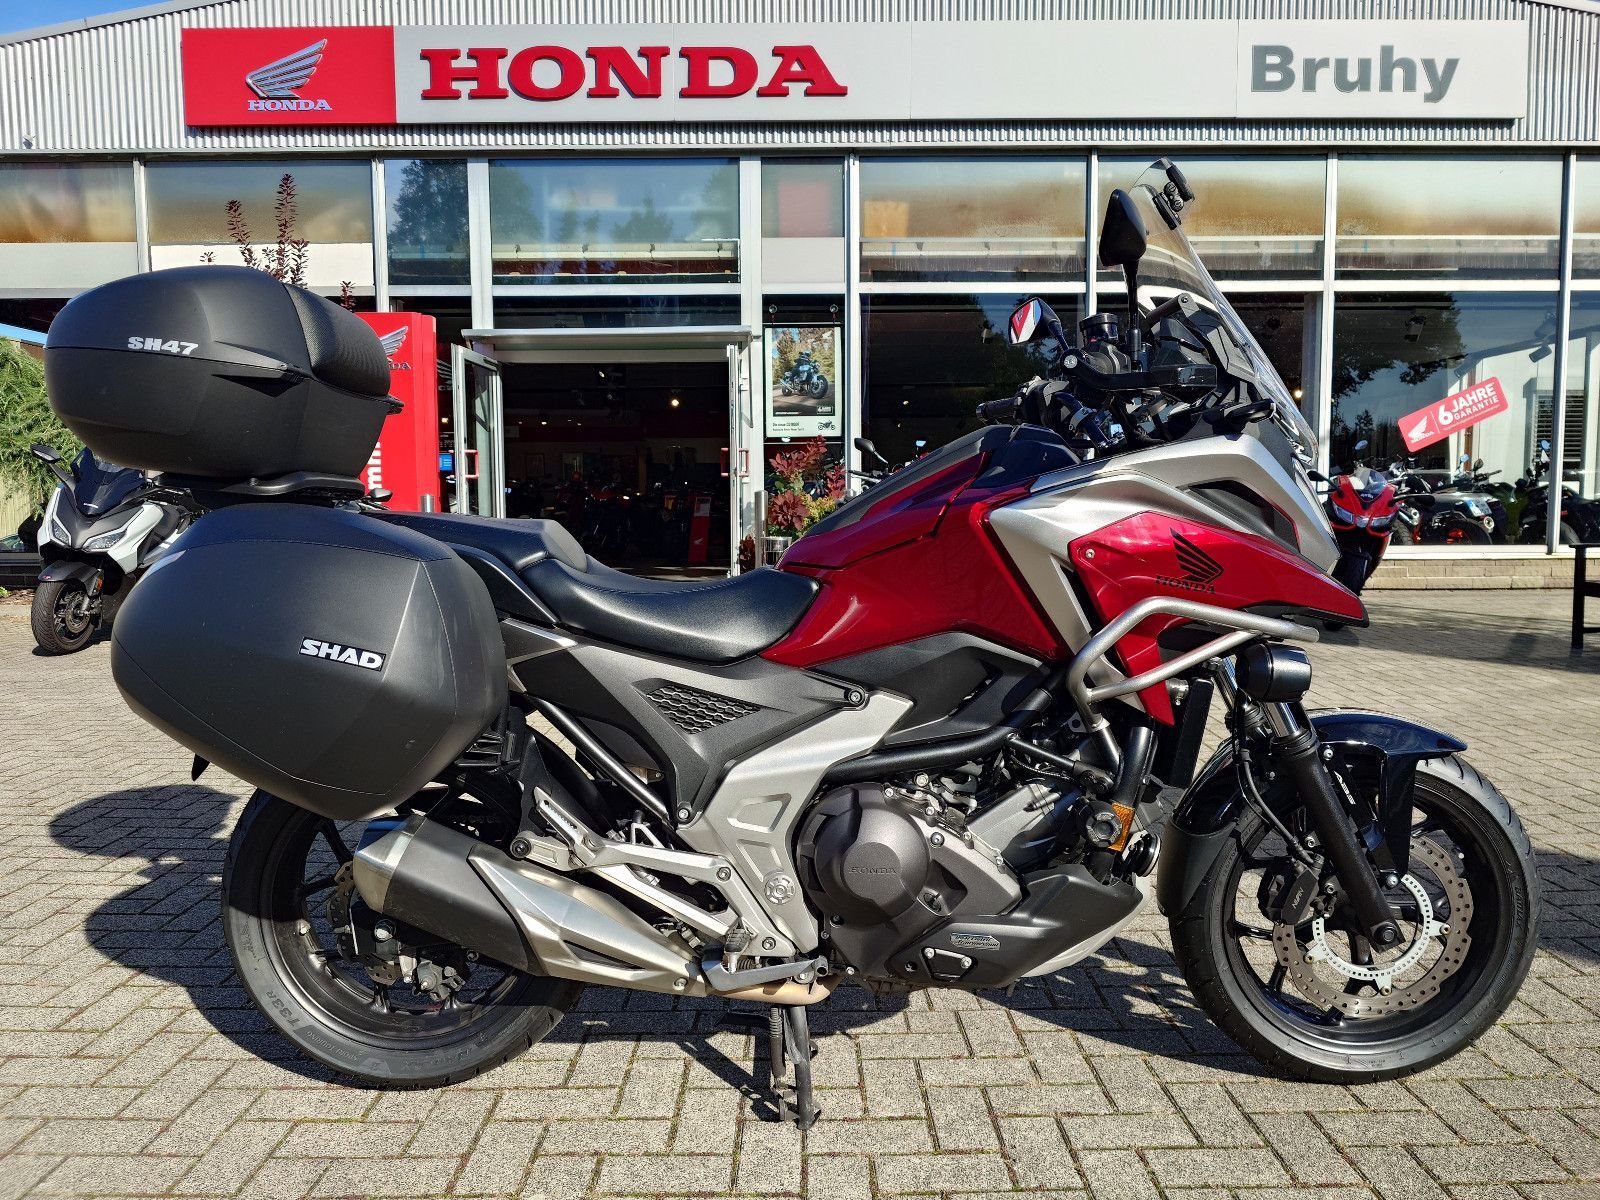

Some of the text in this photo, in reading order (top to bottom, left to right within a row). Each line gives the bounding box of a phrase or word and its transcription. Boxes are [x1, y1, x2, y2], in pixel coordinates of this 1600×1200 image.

[420, 45, 848, 101] HONDA
[1251, 44, 1460, 103] Bruhy
[247, 99, 333, 112] HONDA
[127, 336, 199, 356] SH47
[1438, 404, 1454, 426] 6
[1451, 382, 1496, 413] JAHRE
[1453, 394, 1500, 421] GARANTIE
[1155, 574, 1217, 595] HONDA
[300, 638, 384, 670] SHAD
[848, 866, 897, 875] HONDA
